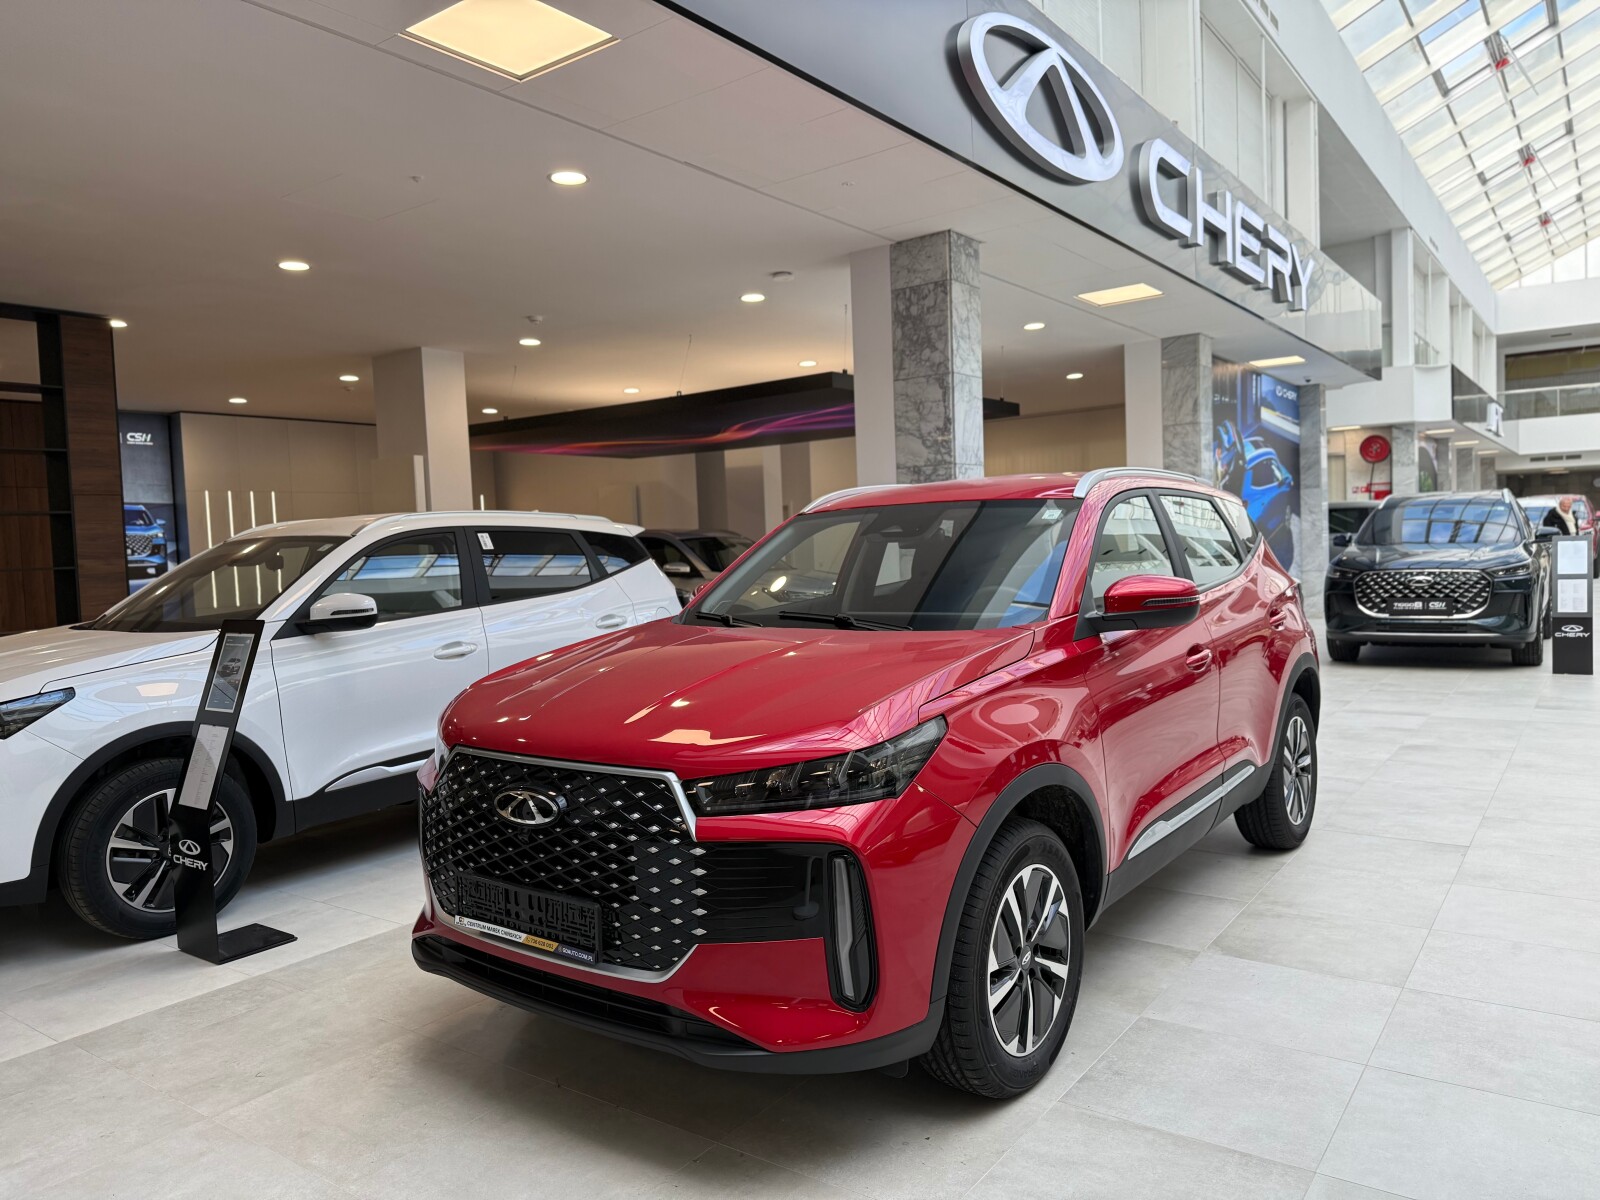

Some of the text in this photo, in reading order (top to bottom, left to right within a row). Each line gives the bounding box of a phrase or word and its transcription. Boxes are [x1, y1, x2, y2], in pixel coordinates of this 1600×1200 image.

[1138, 138, 1315, 311] CHERY
[1554, 631, 1591, 639] CHERY
[173, 854, 209, 871] CHERY
